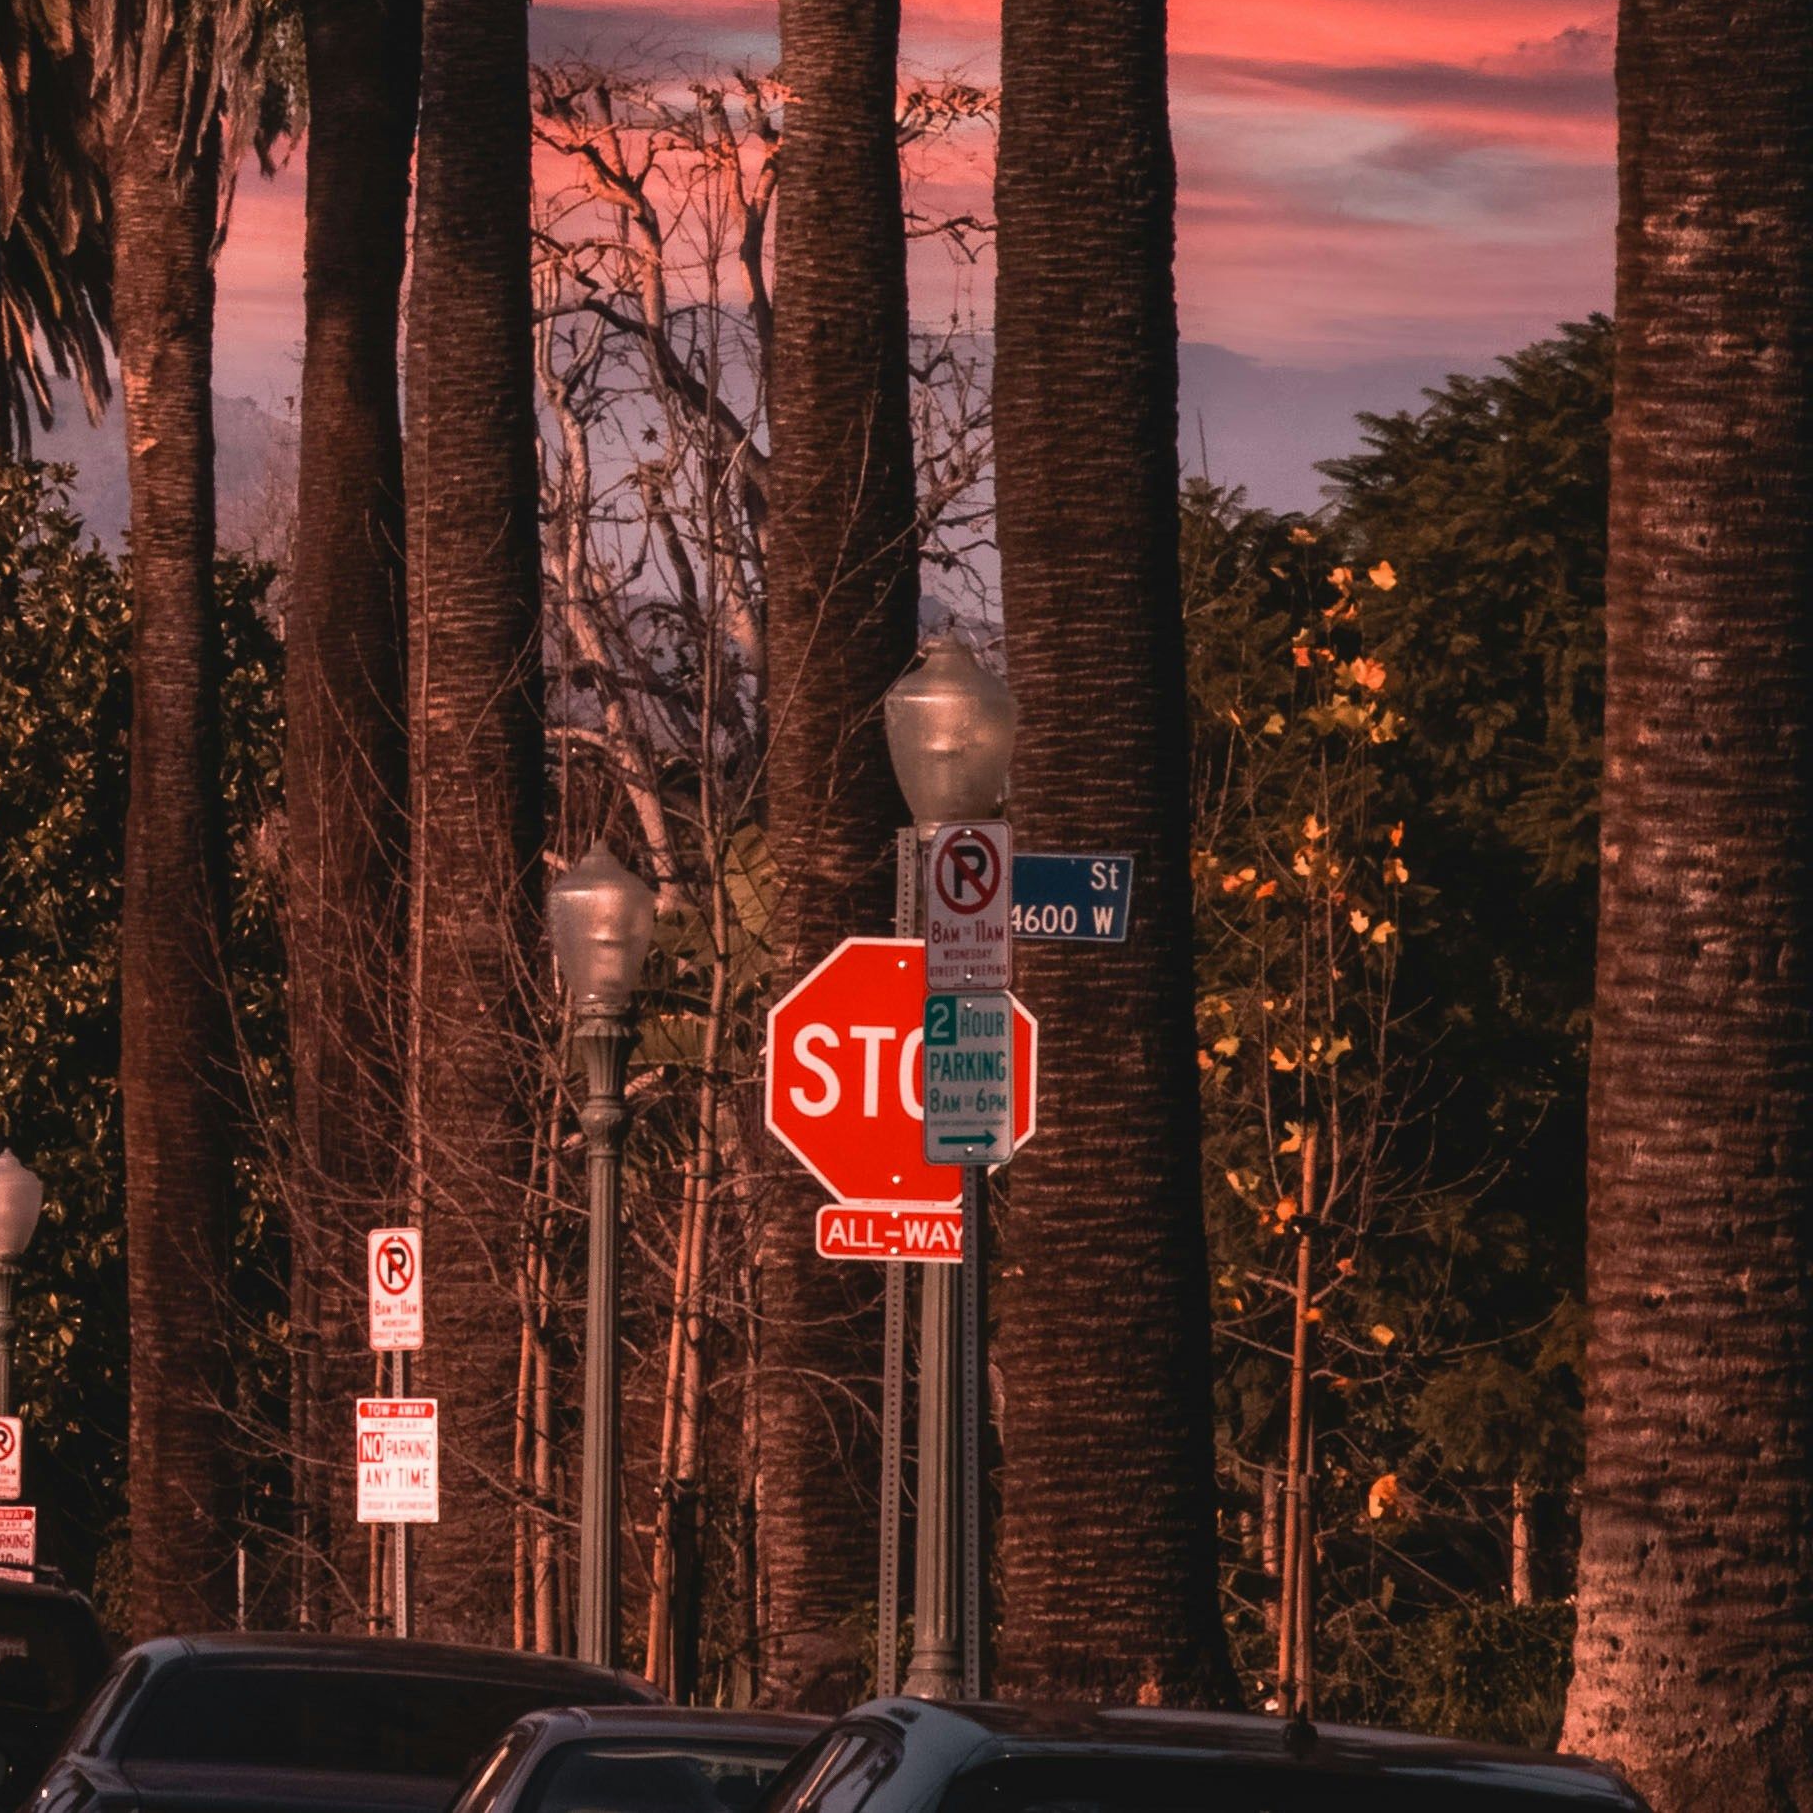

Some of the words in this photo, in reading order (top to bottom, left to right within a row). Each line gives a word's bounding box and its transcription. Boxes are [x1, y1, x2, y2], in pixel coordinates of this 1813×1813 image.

[1090, 861, 1120, 892] St
[931, 920, 960, 945] 8AM
[975, 919, 1005, 942] 11AM
[1011, 904, 1078, 935] 4600
[1092, 906, 1115, 936] W
[930, 1002, 950, 1039] 2
[960, 1010, 1006, 1038] HOUR
[788, 1022, 924, 1122] STO
[929, 1050, 1007, 1083] PARKING
[929, 1087, 961, 1114] 8AM
[975, 1087, 1008, 1113] 6PM
[824, 1217, 963, 1251] ALL-WAY
[367, 1403, 427, 1417] TOW-AWAY
[361, 1433, 383, 1462] NO
[386, 1439, 432, 1461] PARKING
[364, 1467, 391, 1489] ANY
[398, 1467, 430, 1489] TIME
